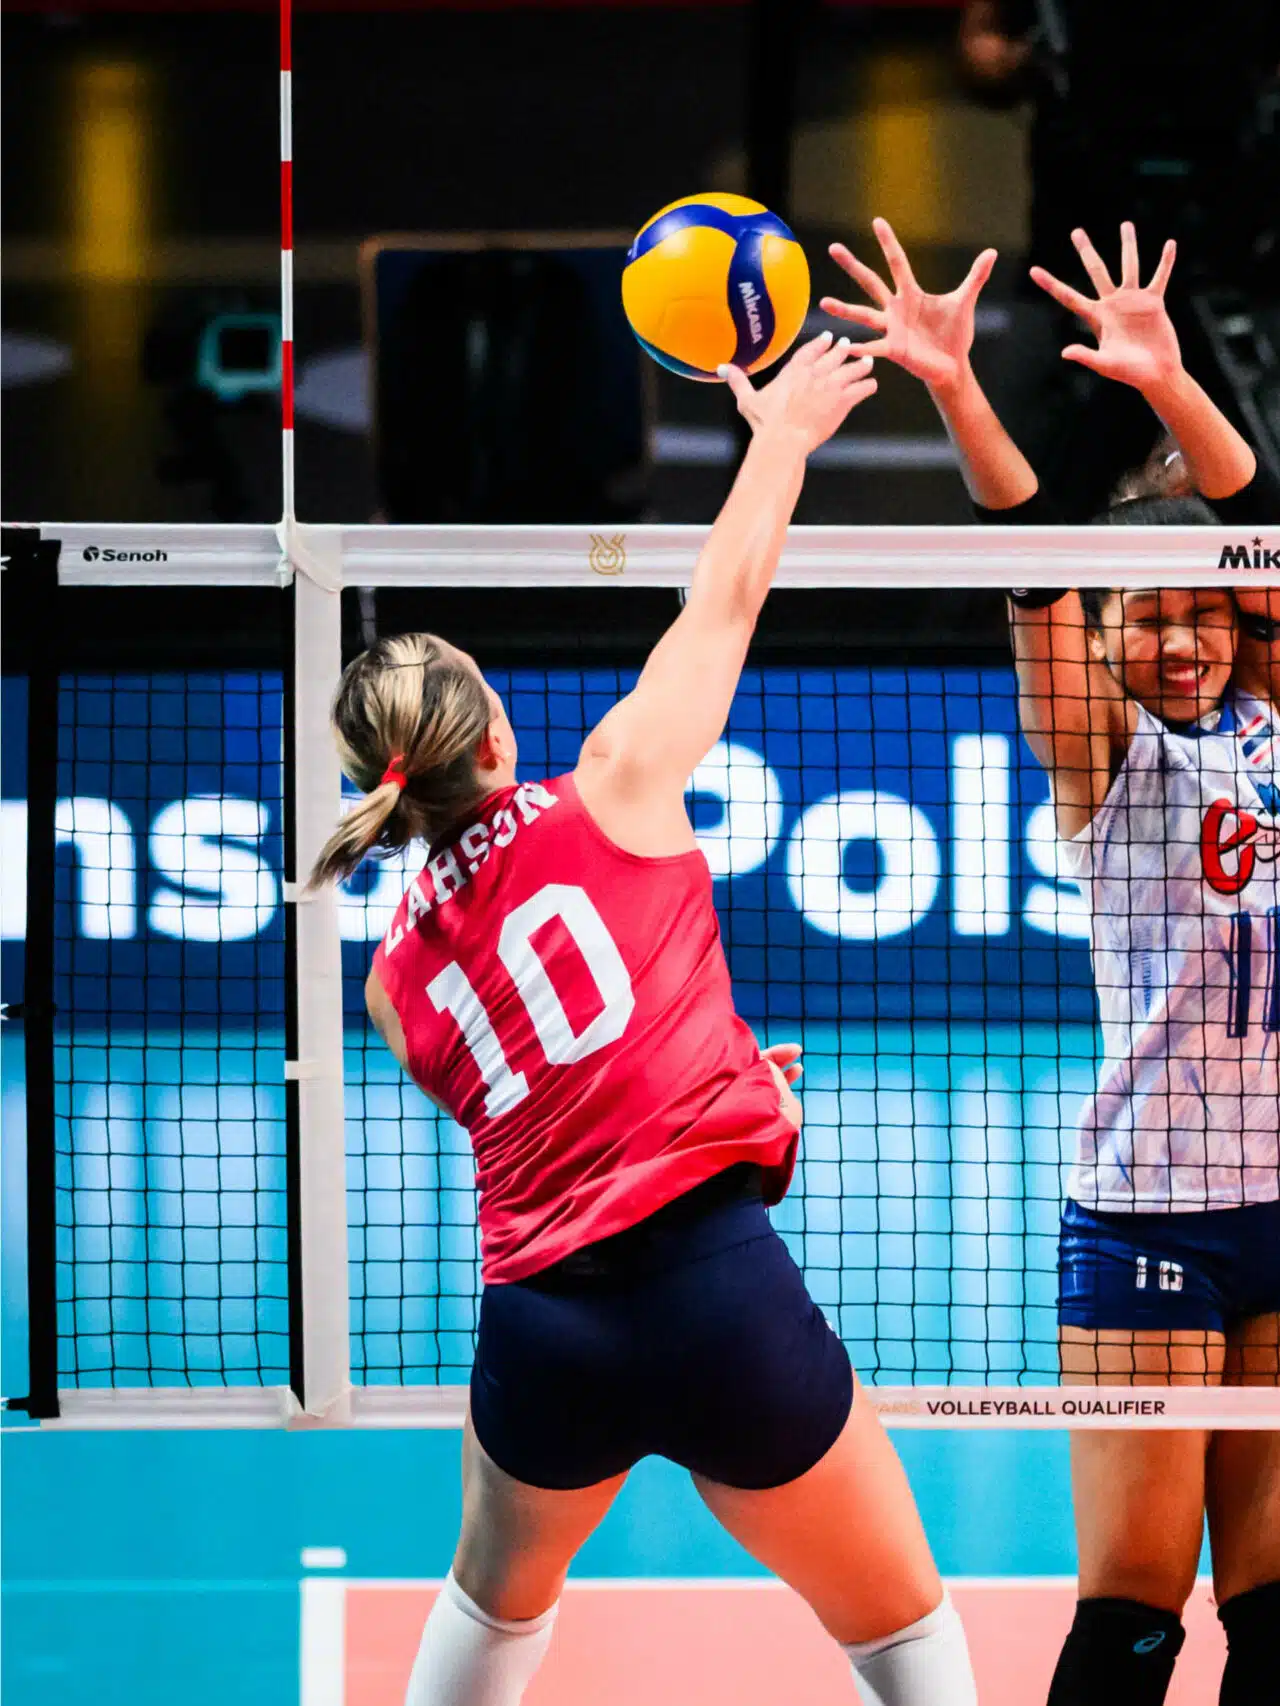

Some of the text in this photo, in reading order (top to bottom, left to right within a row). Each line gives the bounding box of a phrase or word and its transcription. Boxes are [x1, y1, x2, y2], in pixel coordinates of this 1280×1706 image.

[102, 549, 168, 562] Senoh
[425, 883, 636, 1119] 10
[926, 1400, 1056, 1416] VOLLEYBALL
[1061, 1400, 1166, 1416] QUALIFIER
